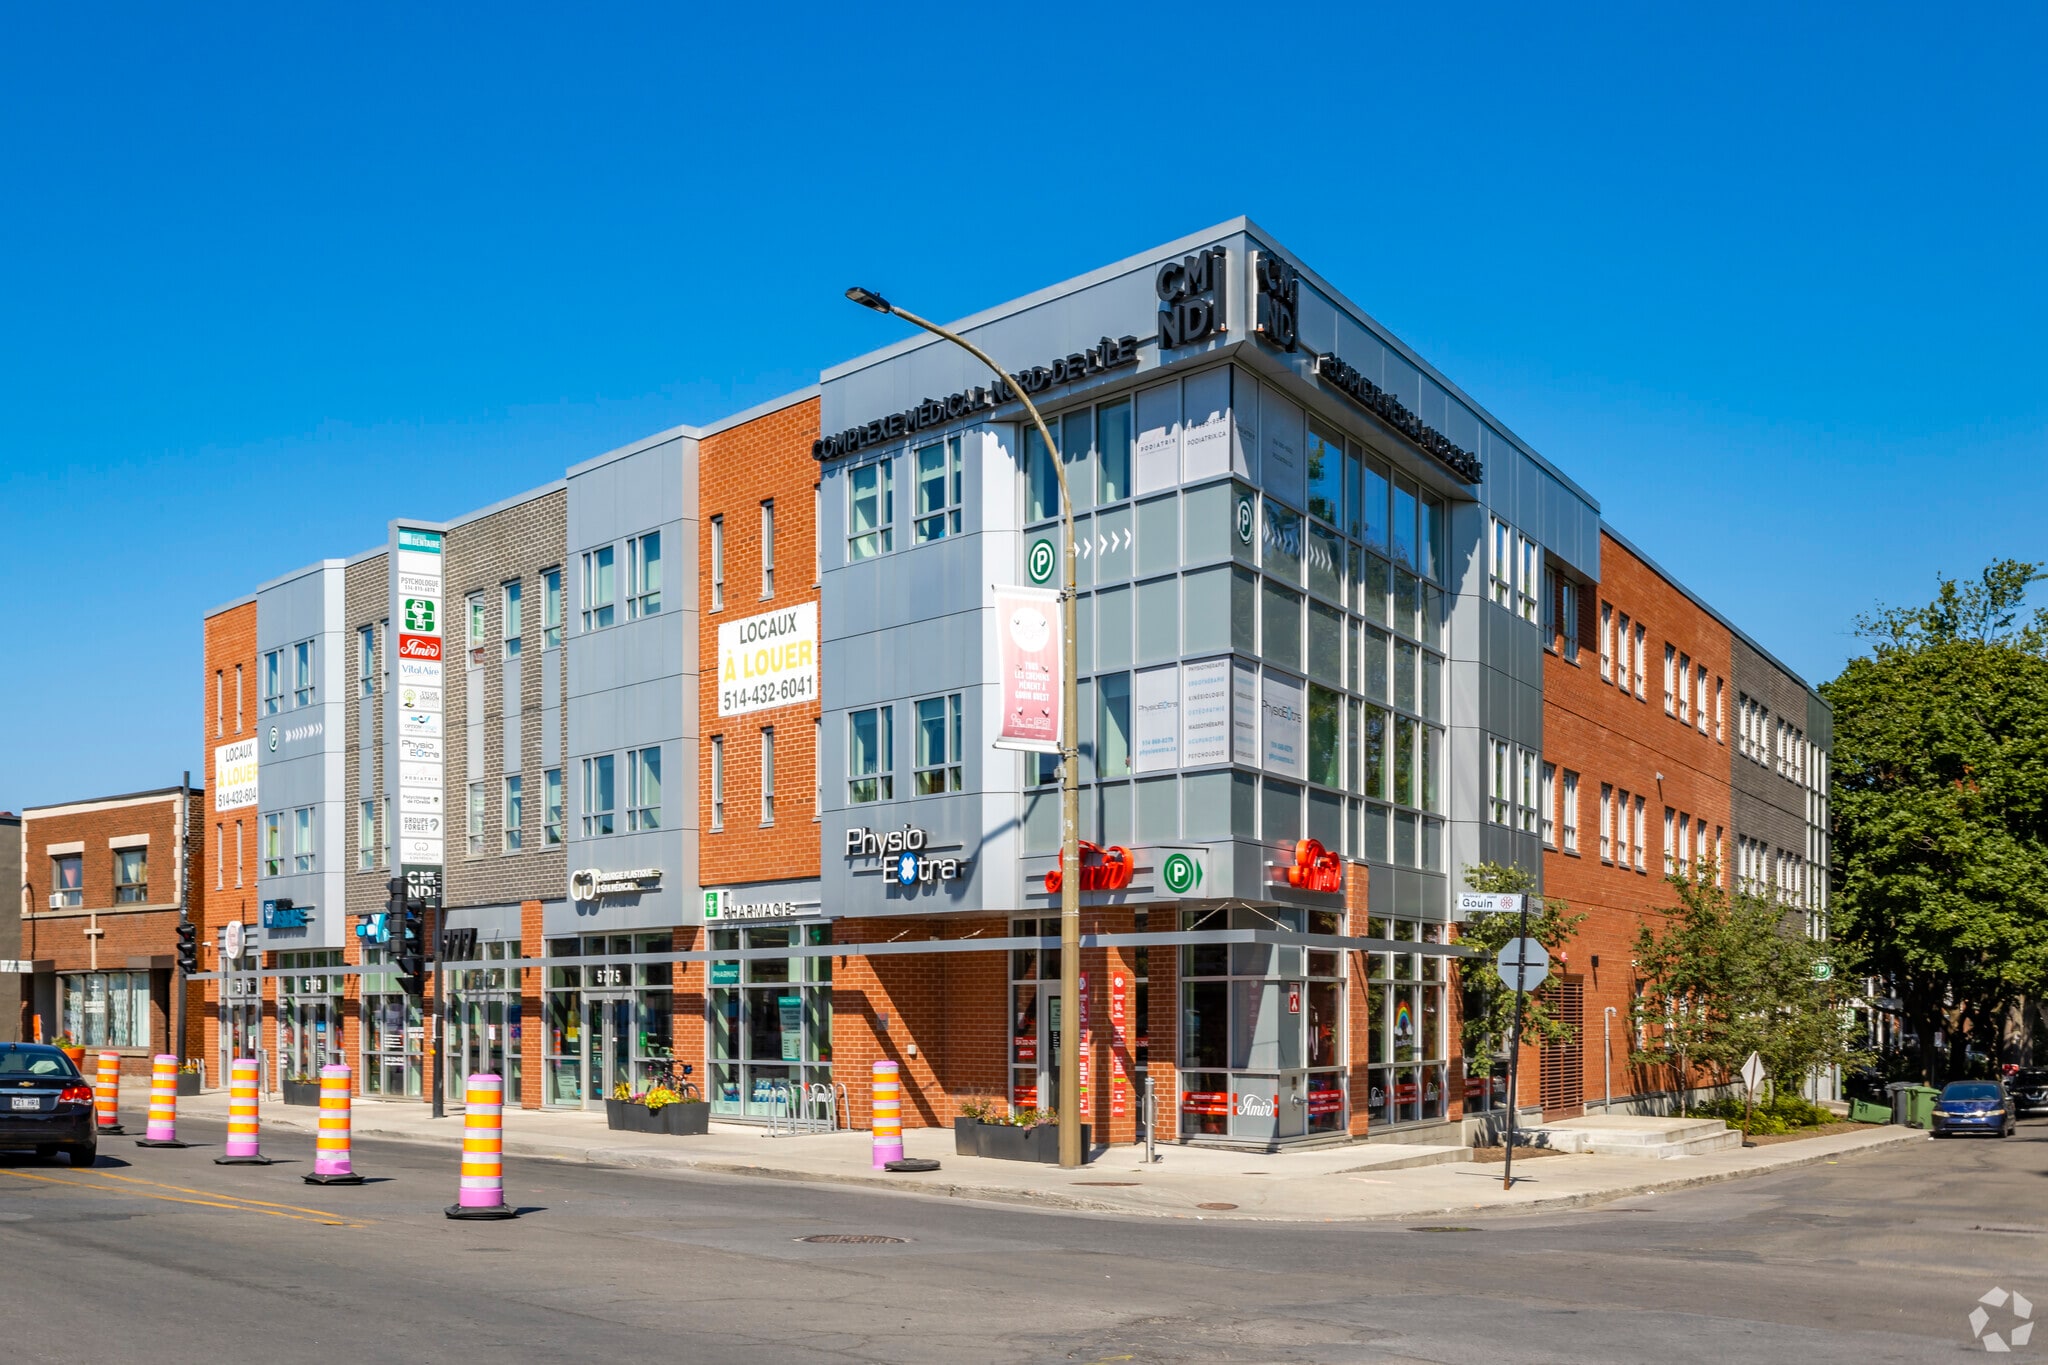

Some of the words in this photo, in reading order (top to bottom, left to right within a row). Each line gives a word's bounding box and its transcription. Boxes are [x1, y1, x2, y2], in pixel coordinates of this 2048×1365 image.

[813, 413, 905, 461] COMPLEXE
[904, 385, 990, 433] MÉDICAL
[400, 577, 439, 588] PSYCHOLOGUE
[740, 612, 797, 645] LOCAUX
[400, 639, 440, 657] Amir
[723, 649, 737, 683] À
[743, 640, 813, 679] LOUER
[723, 675, 813, 711] 514-432-6041
[225, 743, 253, 763] LOCAUX
[845, 823, 924, 860] Physio
[724, 903, 792, 919] PHARMACIE
[1462, 898, 1493, 909] Gouin
[1236, 1093, 1274, 1117] Amir
